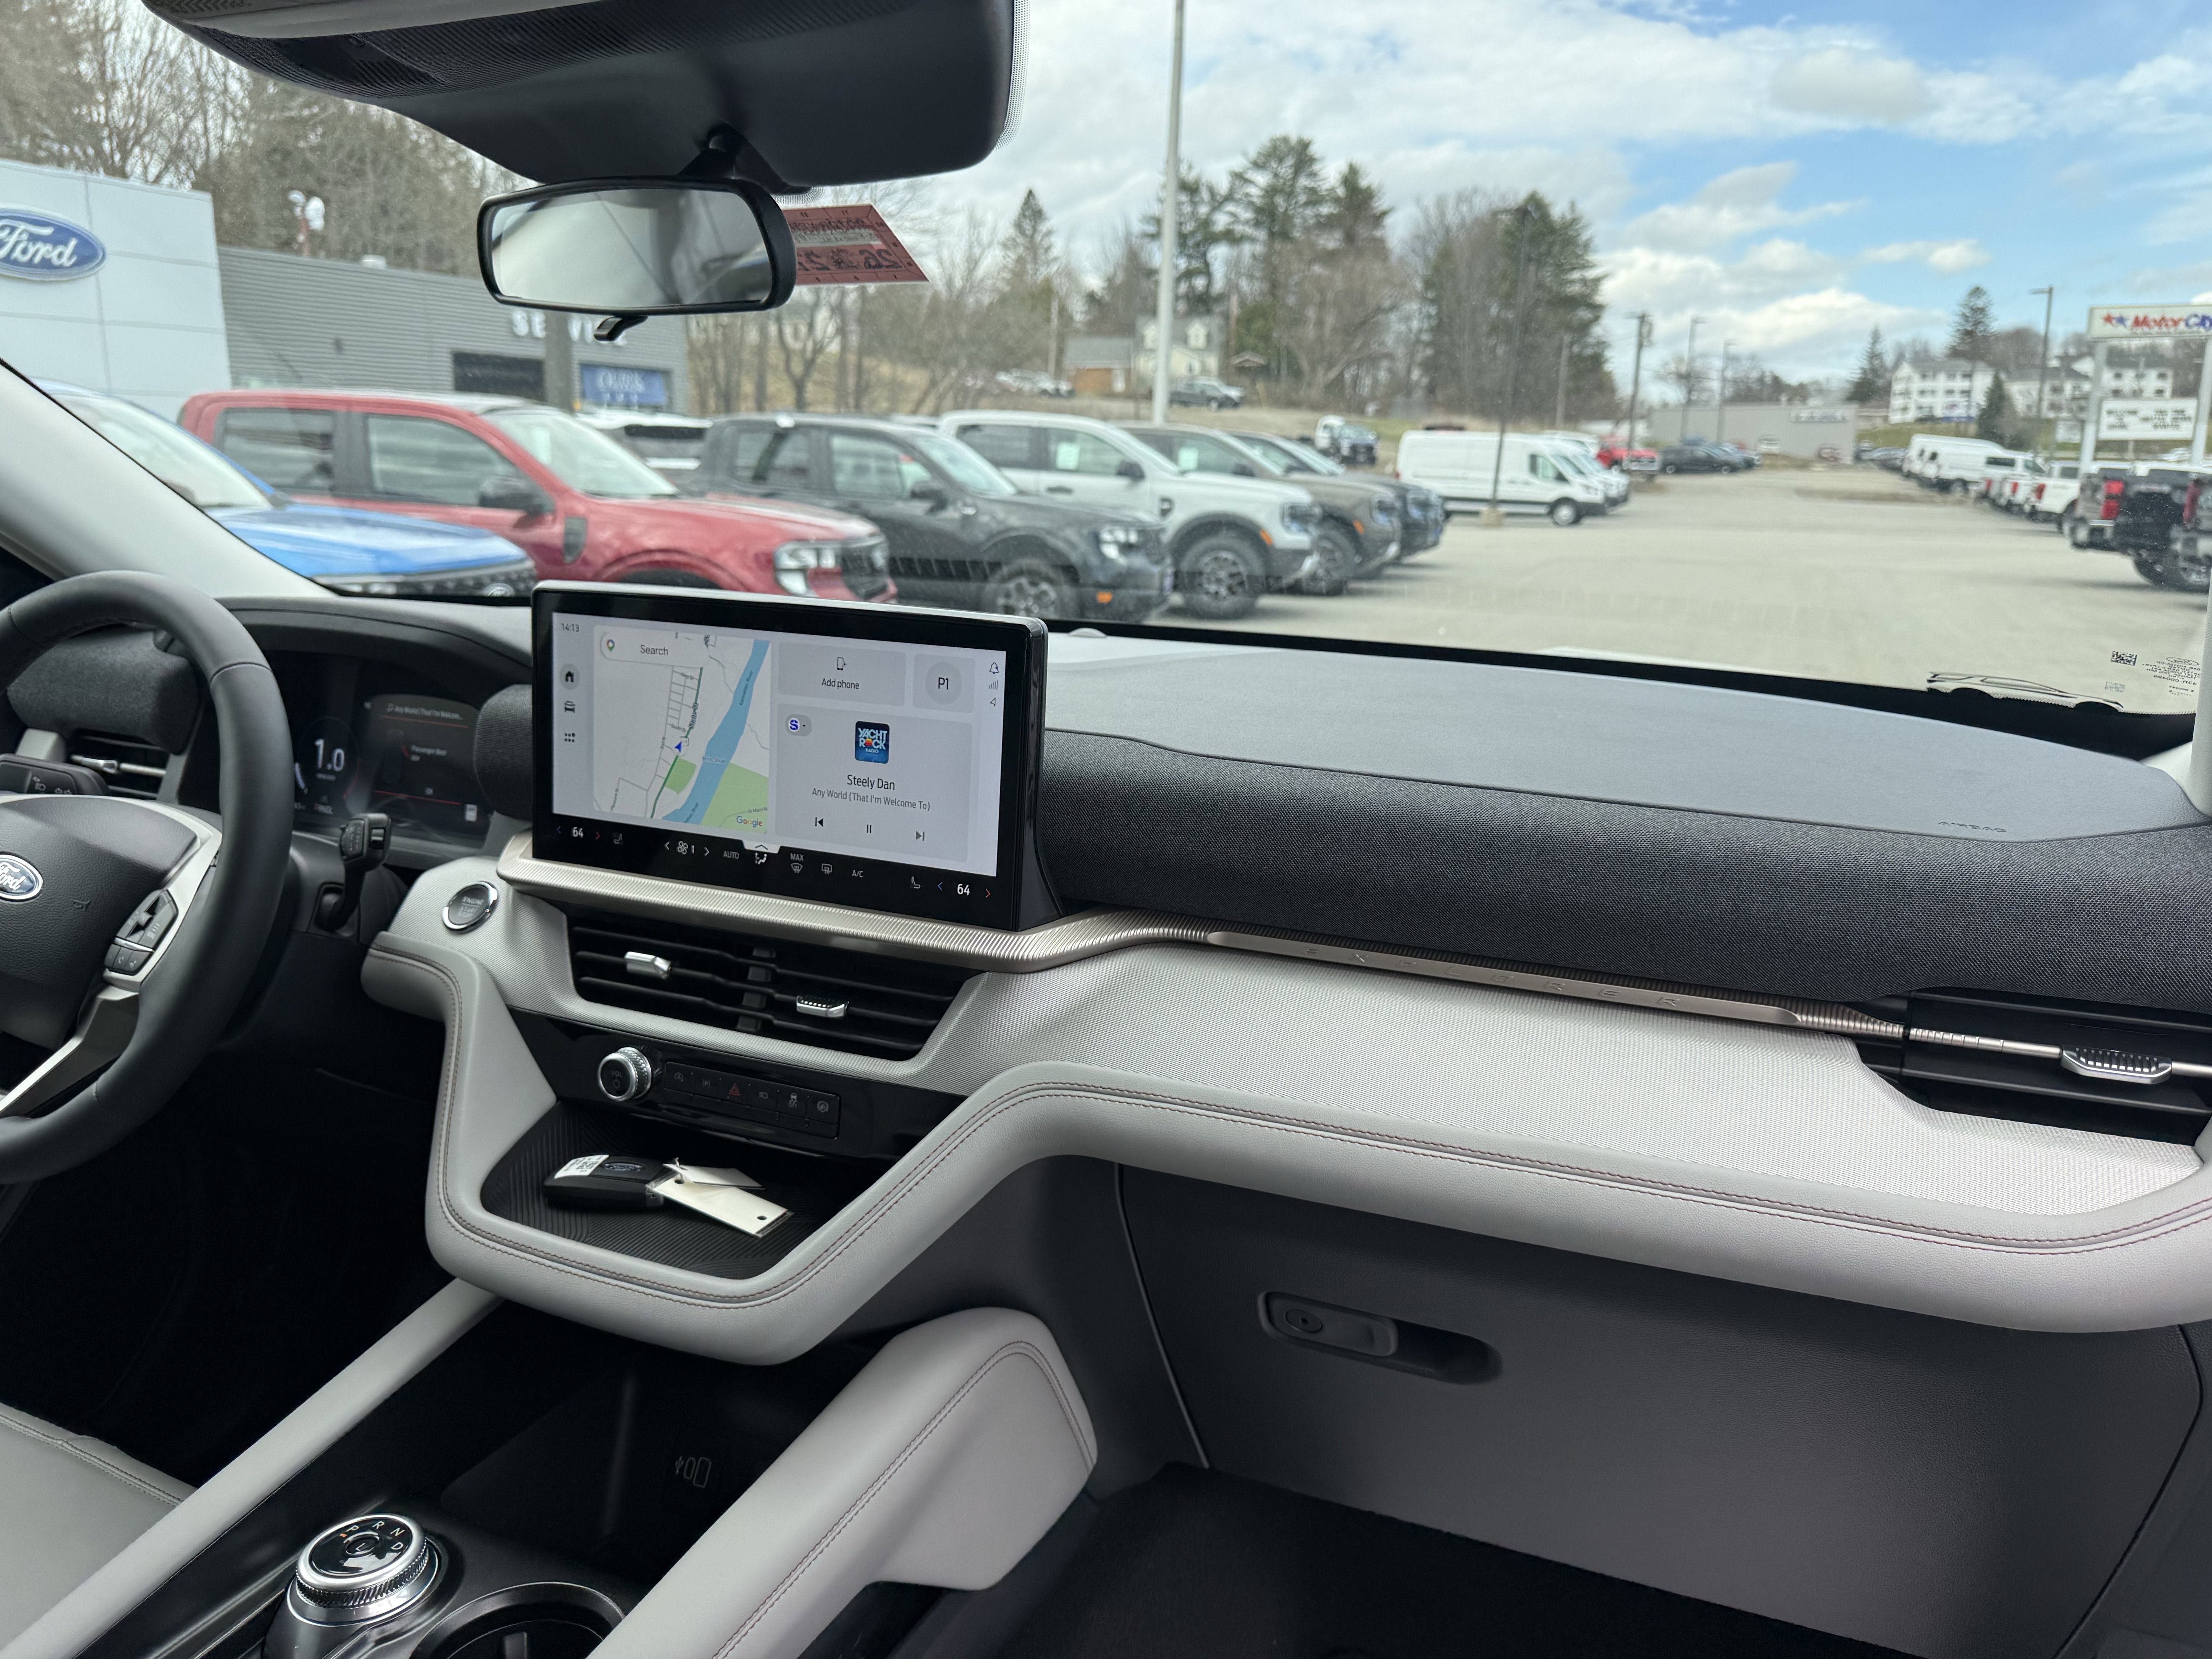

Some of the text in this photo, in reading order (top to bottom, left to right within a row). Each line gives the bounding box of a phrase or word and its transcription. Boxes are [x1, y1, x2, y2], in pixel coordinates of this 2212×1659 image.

[0, 219, 78, 267] Ford
[512, 309, 627, 346] SEVI
[562, 623, 580, 632] 14:13
[640, 644, 669, 656] Search
[821, 678, 860, 690] Add phone
[938, 677, 949, 690] P1
[857, 727, 888, 741] YACHT
[314, 738, 345, 771] 1.0
[847, 774, 895, 790] Steely Dan
[812, 787, 930, 812] Any World (That I'm Welcome To)
[736, 815, 763, 828] Google
[1938, 821, 2007, 833] AIRBAG
[571, 826, 584, 838] 64
[723, 851, 740, 860] AUTO
[790, 853, 804, 862] MAX
[0, 862, 26, 890] Ford
[852, 870, 864, 878] A/C
[957, 883, 970, 896] 64
[462, 896, 484, 905] ENGINE
[1305, 946, 1680, 1007] EXPLORER
[611, 1070, 623, 1078] VOL
[372, 1521, 385, 1529] R
[390, 1527, 405, 1537] N
[355, 1542, 366, 1551] L
[390, 1542, 404, 1550] D
